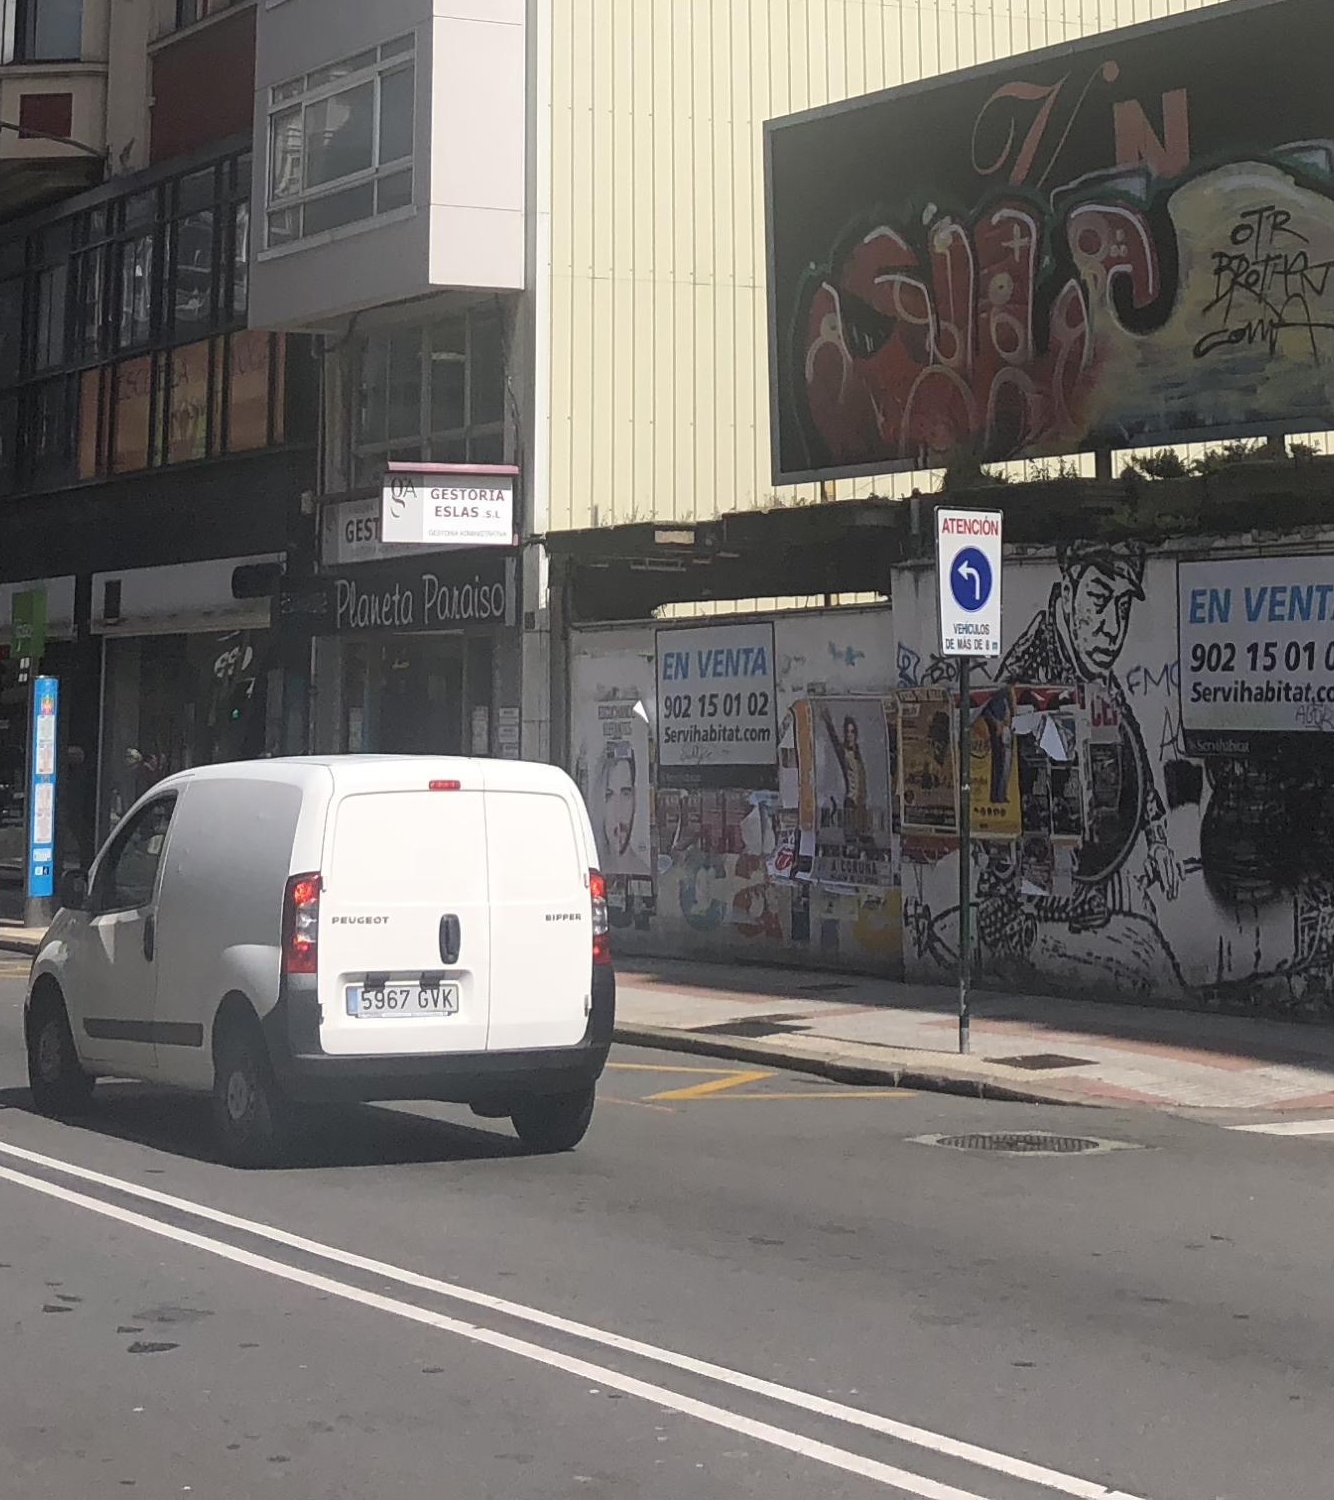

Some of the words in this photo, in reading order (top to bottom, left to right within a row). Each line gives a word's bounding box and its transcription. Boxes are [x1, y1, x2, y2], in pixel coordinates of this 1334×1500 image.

[430, 488, 506, 502] GESTORIA
[434, 505, 480, 519] ESLAS
[941, 516, 999, 536] ATENCIÓN
[334, 579, 414, 629] Planeta
[422, 573, 506, 625] Paraiso
[1188, 587, 1232, 624] EN
[953, 620, 990, 636] VEHÍCULOS
[945, 638, 955, 650] DE
[957, 636, 971, 651] MÁS
[974, 638, 983, 651] DE
[662, 652, 690, 681] EN
[698, 647, 768, 679] VENTA
[1189, 642, 1236, 673] 902
[1246, 642, 1278, 672] 15
[1284, 641, 1316, 672] 01
[664, 695, 692, 719] 902
[698, 693, 719, 718] 15
[723, 692, 741, 717] 01
[748, 691, 769, 717] 02
[664, 724, 771, 744] Servihabitat.com
[331, 915, 390, 925] PEUGEOT
[361, 989, 411, 1010] 5967
[417, 988, 454, 1009] GVK
